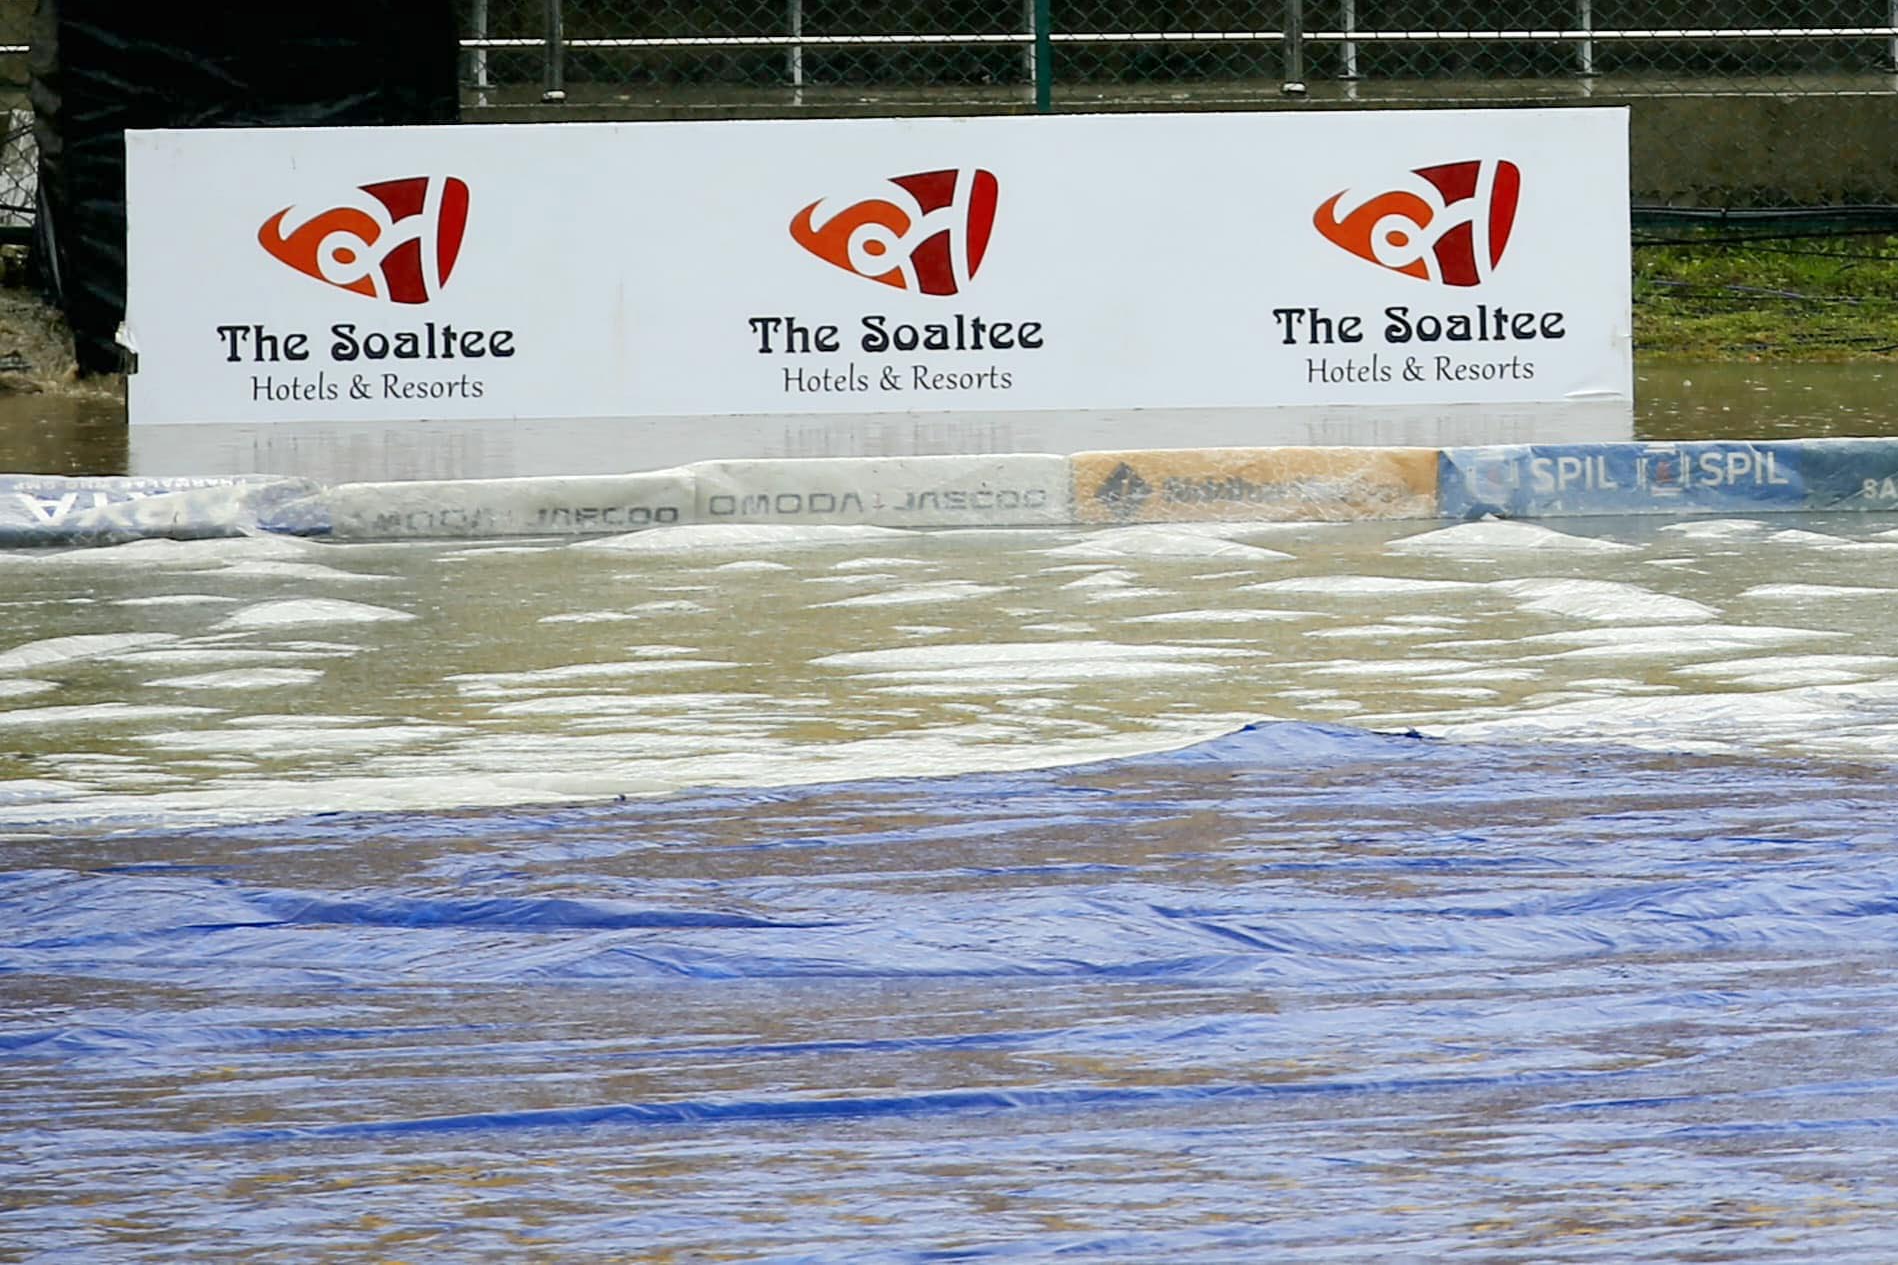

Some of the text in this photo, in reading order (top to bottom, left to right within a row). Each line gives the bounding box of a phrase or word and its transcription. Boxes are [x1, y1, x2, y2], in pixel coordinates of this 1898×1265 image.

[217, 323, 516, 362] The Soaltee
[748, 314, 1044, 353] The Soaltee
[1273, 304, 1566, 344] The Soaltee
[250, 371, 484, 401] Hotels & Resorts
[782, 362, 1012, 392] Hotels & Resorts
[1305, 353, 1534, 383] Hotels & Resorts
[1530, 451, 1789, 493] SPIL SPIL
